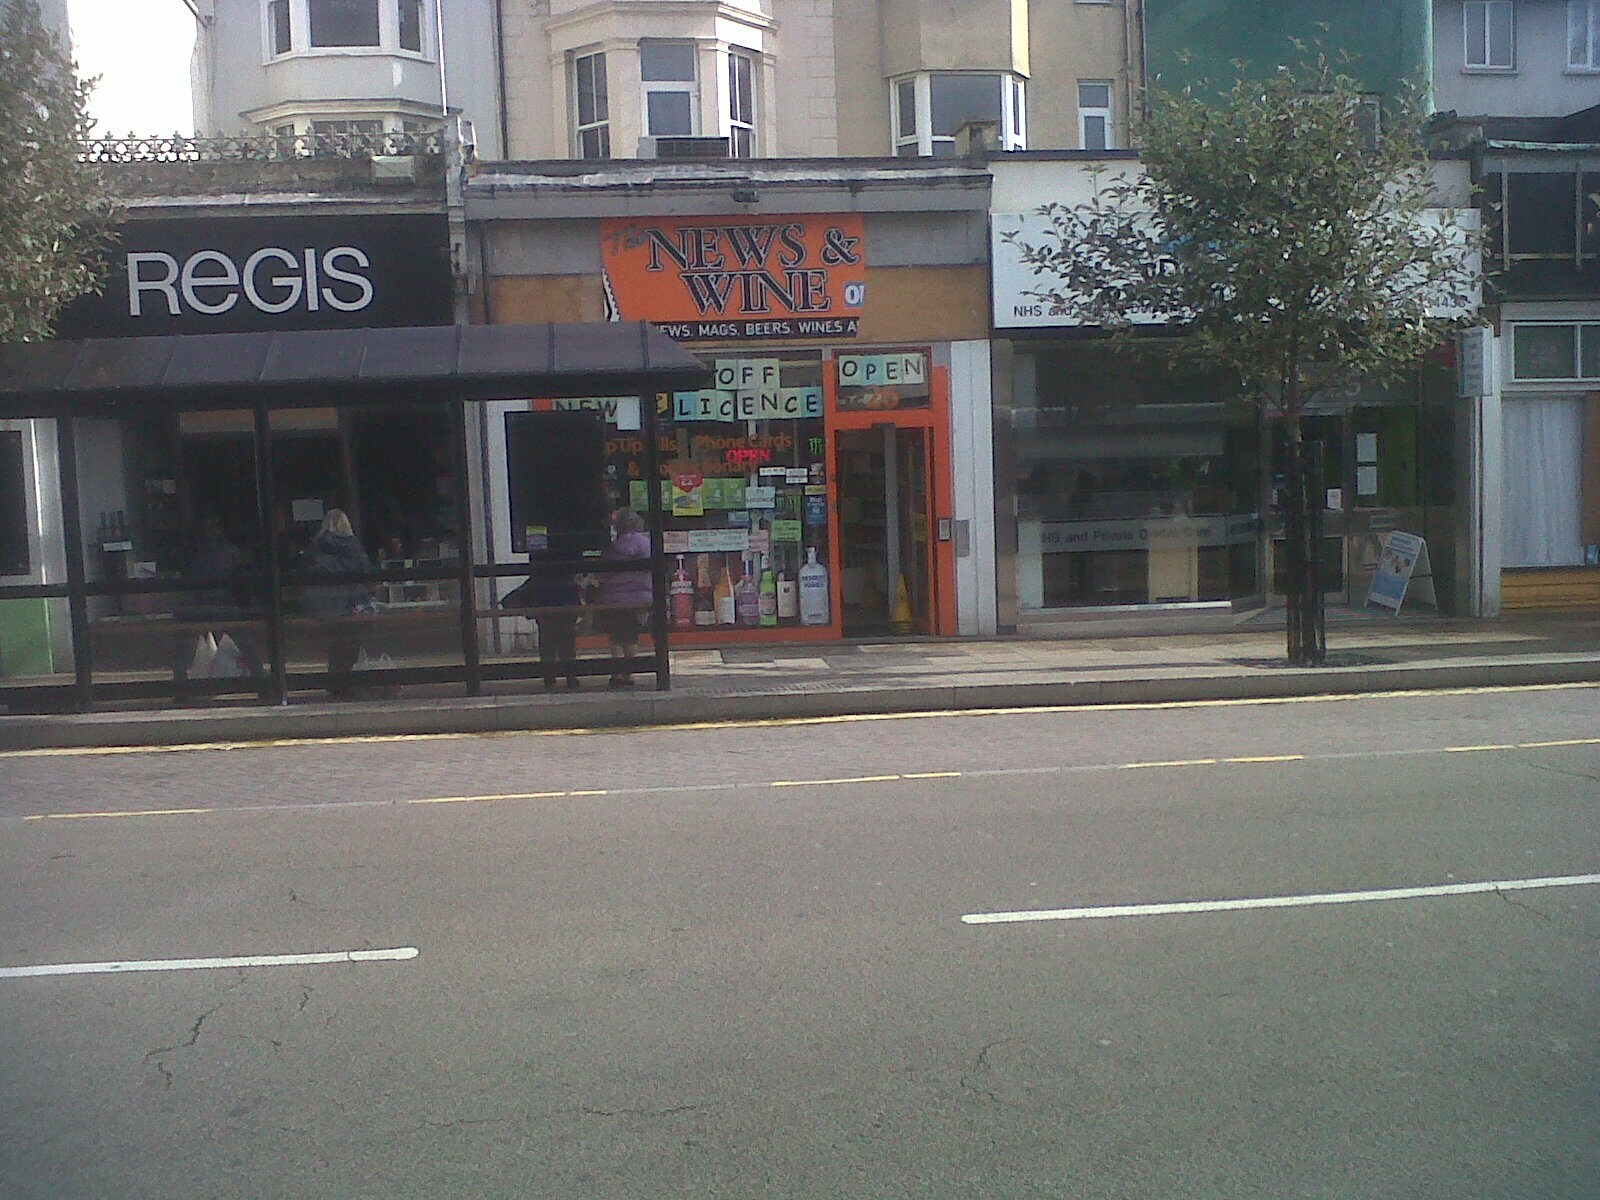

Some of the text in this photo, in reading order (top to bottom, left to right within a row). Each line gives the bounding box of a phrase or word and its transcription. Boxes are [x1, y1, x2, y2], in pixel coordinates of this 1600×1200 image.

[646, 224, 860, 272] NEWS &
[679, 269, 831, 316] WINE
[1013, 305, 1043, 318] NHS
[798, 320, 844, 334] WINES
[718, 366, 774, 385] OFF
[842, 358, 921, 381] OPEN
[679, 393, 818, 417] LICENCE
[748, 431, 792, 448] Cards
